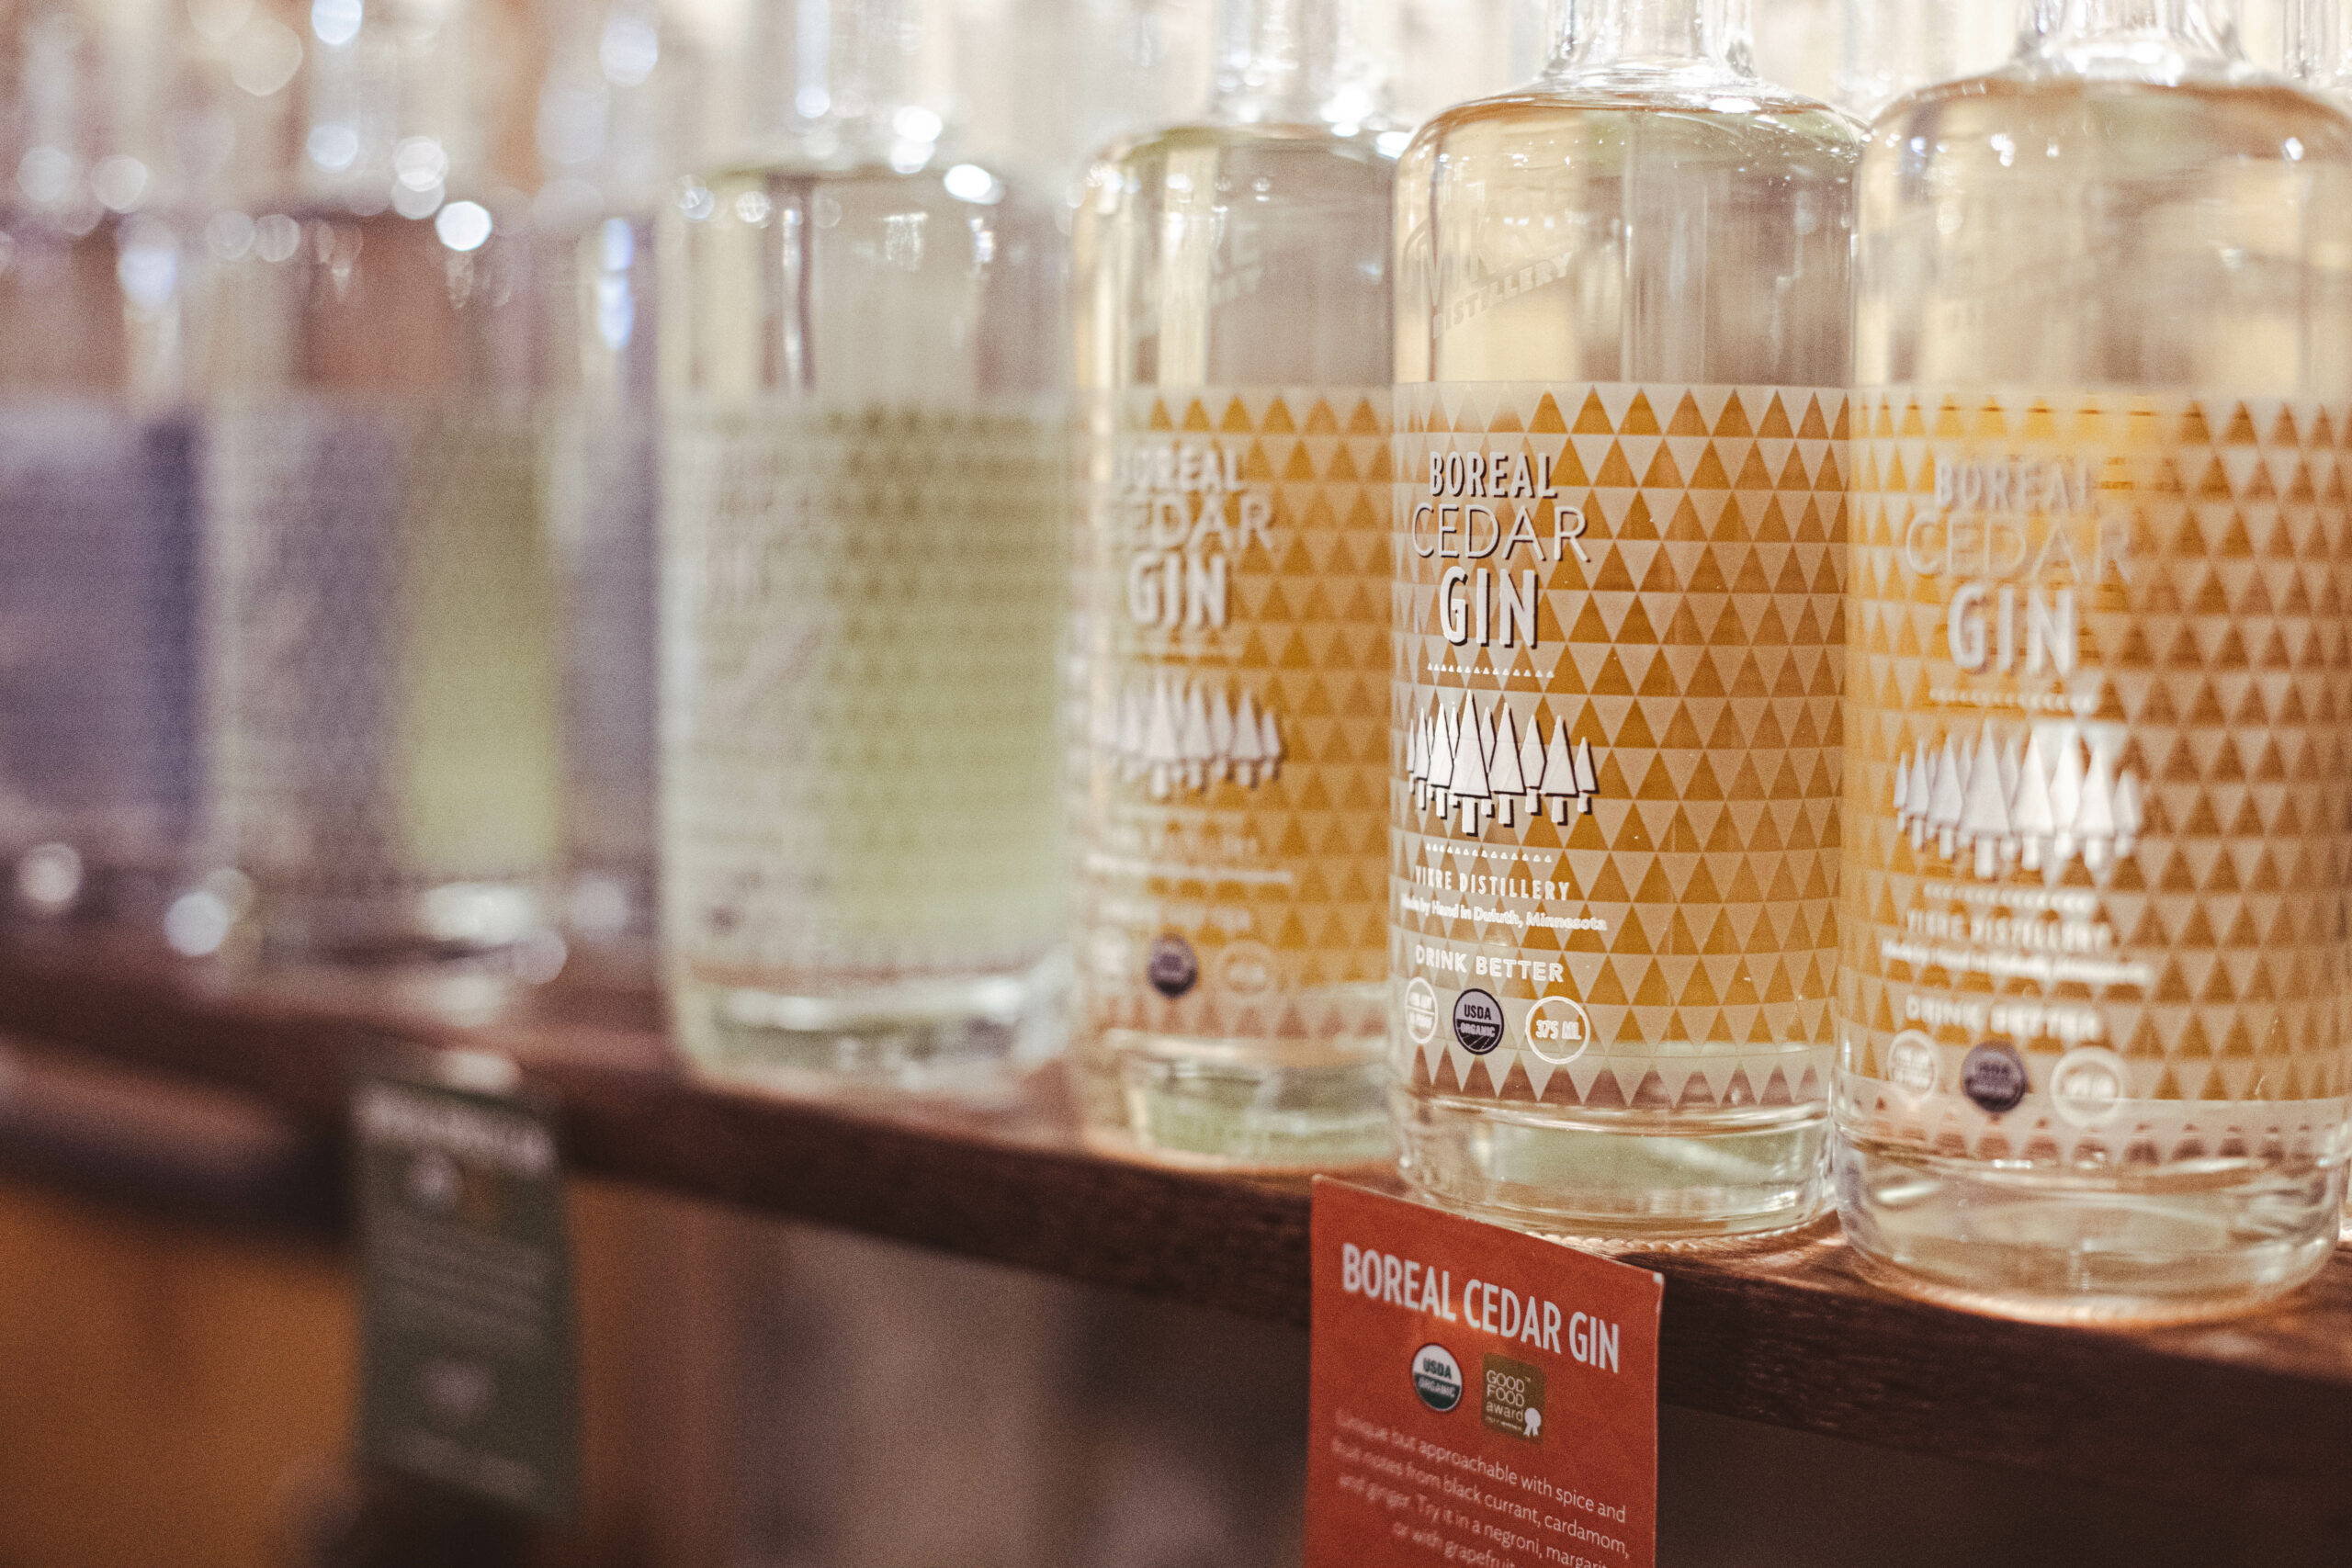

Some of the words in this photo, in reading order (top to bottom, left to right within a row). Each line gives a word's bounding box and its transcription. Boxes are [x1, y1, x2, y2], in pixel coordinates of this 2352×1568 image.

[1429, 451, 1559, 499] BOREAL
[1411, 502, 1591, 562] CEDAR
[1128, 551, 1231, 626] GIN
[1439, 566, 1538, 649] GIN
[1947, 581, 2078, 678] GIN
[1459, 872, 1570, 901] DISTILLERY
[1461, 902, 1472, 919] in
[1473, 906, 1524, 929] Duluth,
[1525, 910, 1608, 931] Minnesota
[1415, 944, 1468, 974] DRINK
[1476, 954, 1565, 983] BETTER
[1464, 1003, 1492, 1021] USDA
[1460, 1021, 1497, 1039] ORGANIC
[1535, 1019, 1559, 1040] 375
[1341, 1242, 1457, 1323] BOREAL
[1463, 1278, 1562, 1354] CEDAR
[1568, 1310, 1620, 1374] GIN
[1422, 1357, 1453, 1380] USDA
[1486, 1369, 1525, 1393] GOOD
[1417, 1376, 1456, 1399] ORGANIC
[1486, 1384, 1525, 1407] FOOD
[1486, 1401, 1523, 1422] award
[1390, 1427, 1416, 1451] but
[1419, 1440, 1518, 1485] approachable
[1521, 1475, 1553, 1497] with
[1555, 1487, 1594, 1512] spice
[1597, 1501, 1626, 1524] and
[1406, 1461, 1442, 1489] from
[1443, 1473, 1481, 1504] black
[1484, 1494, 1542, 1528] currant,
[1544, 1515, 1630, 1559] cardamom,
[1417, 1492, 1441, 1523] Try
[1442, 1508, 1453, 1526] it
[1455, 1511, 1470, 1529] in
[1472, 1519, 1482, 1534] a
[1484, 1524, 1543, 1559] negroni,
